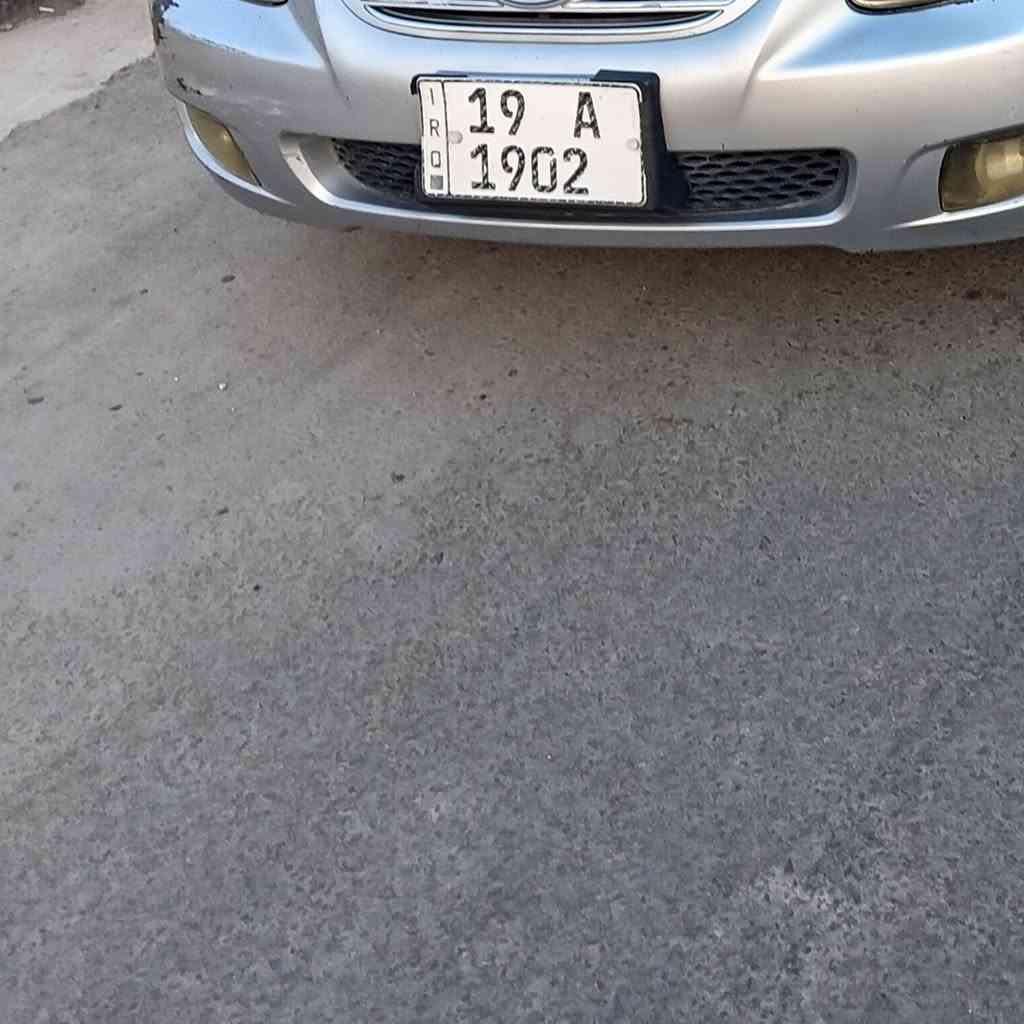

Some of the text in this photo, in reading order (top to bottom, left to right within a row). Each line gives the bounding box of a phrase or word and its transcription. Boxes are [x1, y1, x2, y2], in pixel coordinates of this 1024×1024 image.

[468, 87, 601, 139] 19 A
[470, 143, 589, 195] 1902
